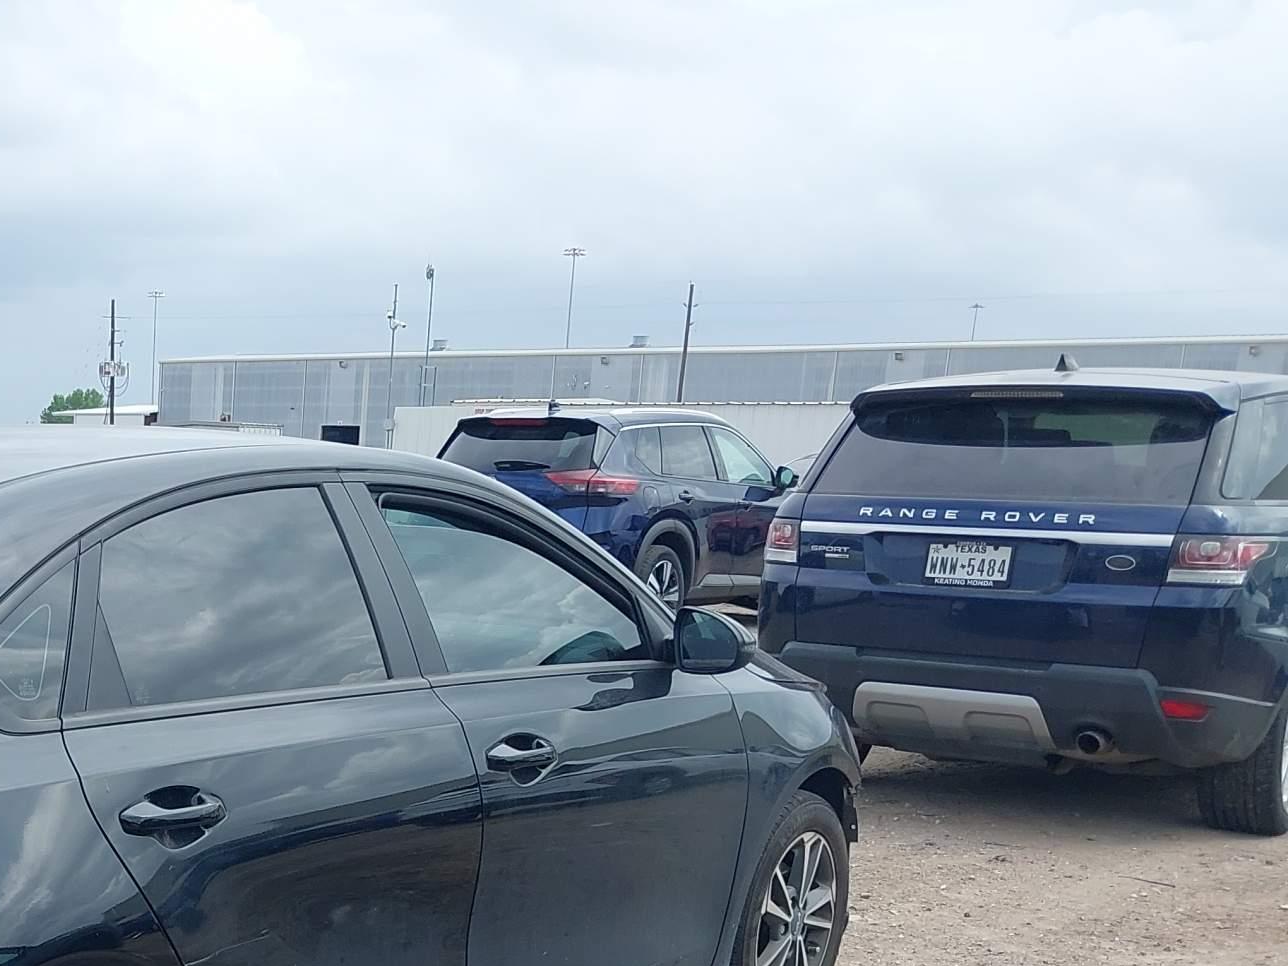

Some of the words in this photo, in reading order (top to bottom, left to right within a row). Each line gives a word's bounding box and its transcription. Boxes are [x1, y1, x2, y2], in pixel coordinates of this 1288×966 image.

[859, 506, 959, 520] RANGE
[980, 510, 1097, 525] ROVER
[810, 544, 851, 553] SPORT
[955, 545, 987, 554] TEXAS
[934, 577, 966, 586] KEATING
[966, 579, 994, 588] HONDA
